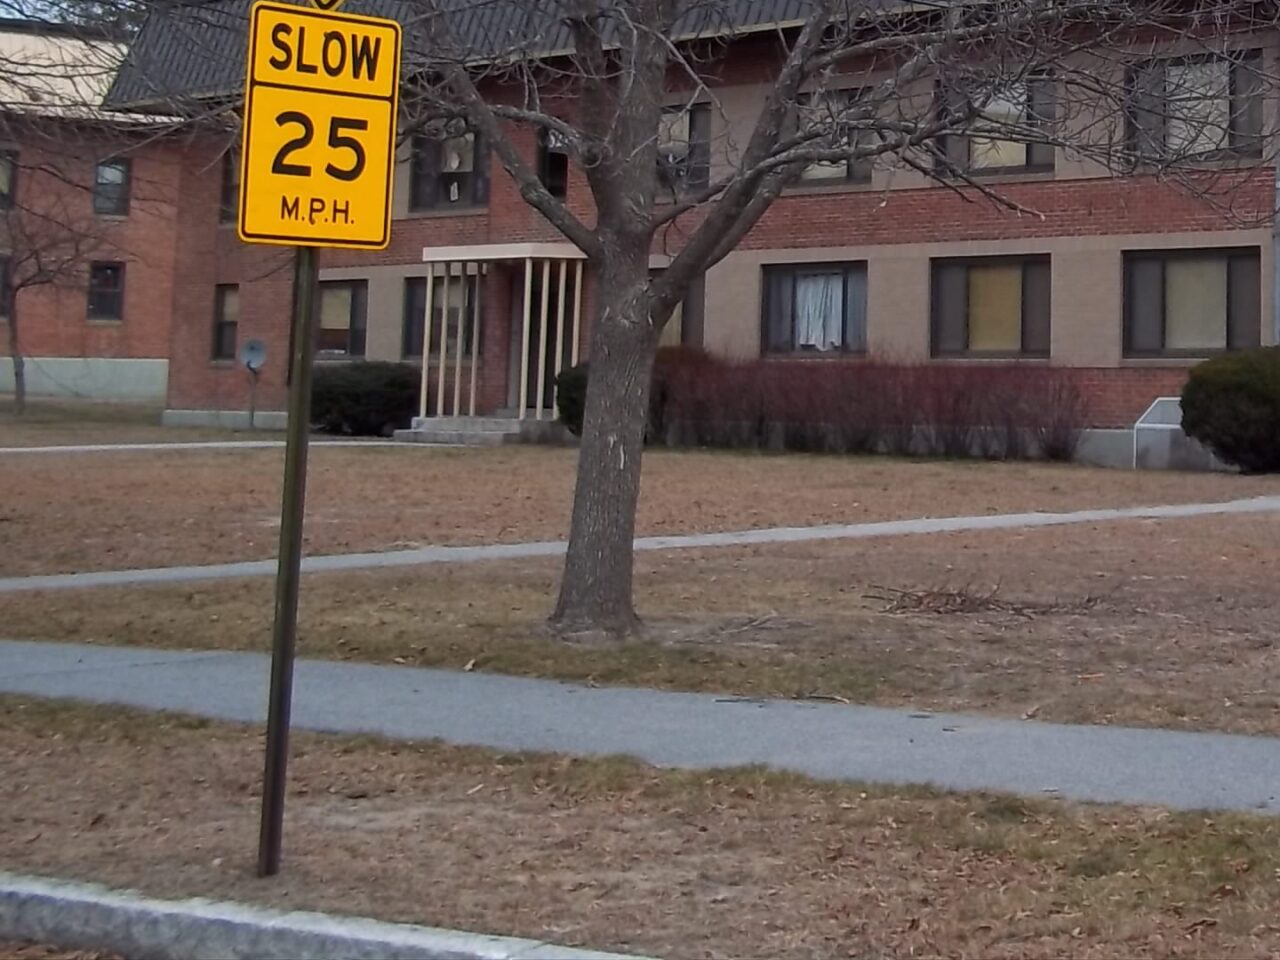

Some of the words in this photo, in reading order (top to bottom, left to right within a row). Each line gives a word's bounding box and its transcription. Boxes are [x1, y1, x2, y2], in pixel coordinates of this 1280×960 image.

[269, 23, 381, 81] SLOW
[271, 111, 368, 181] 25
[281, 195, 354, 224] M.P.H.
